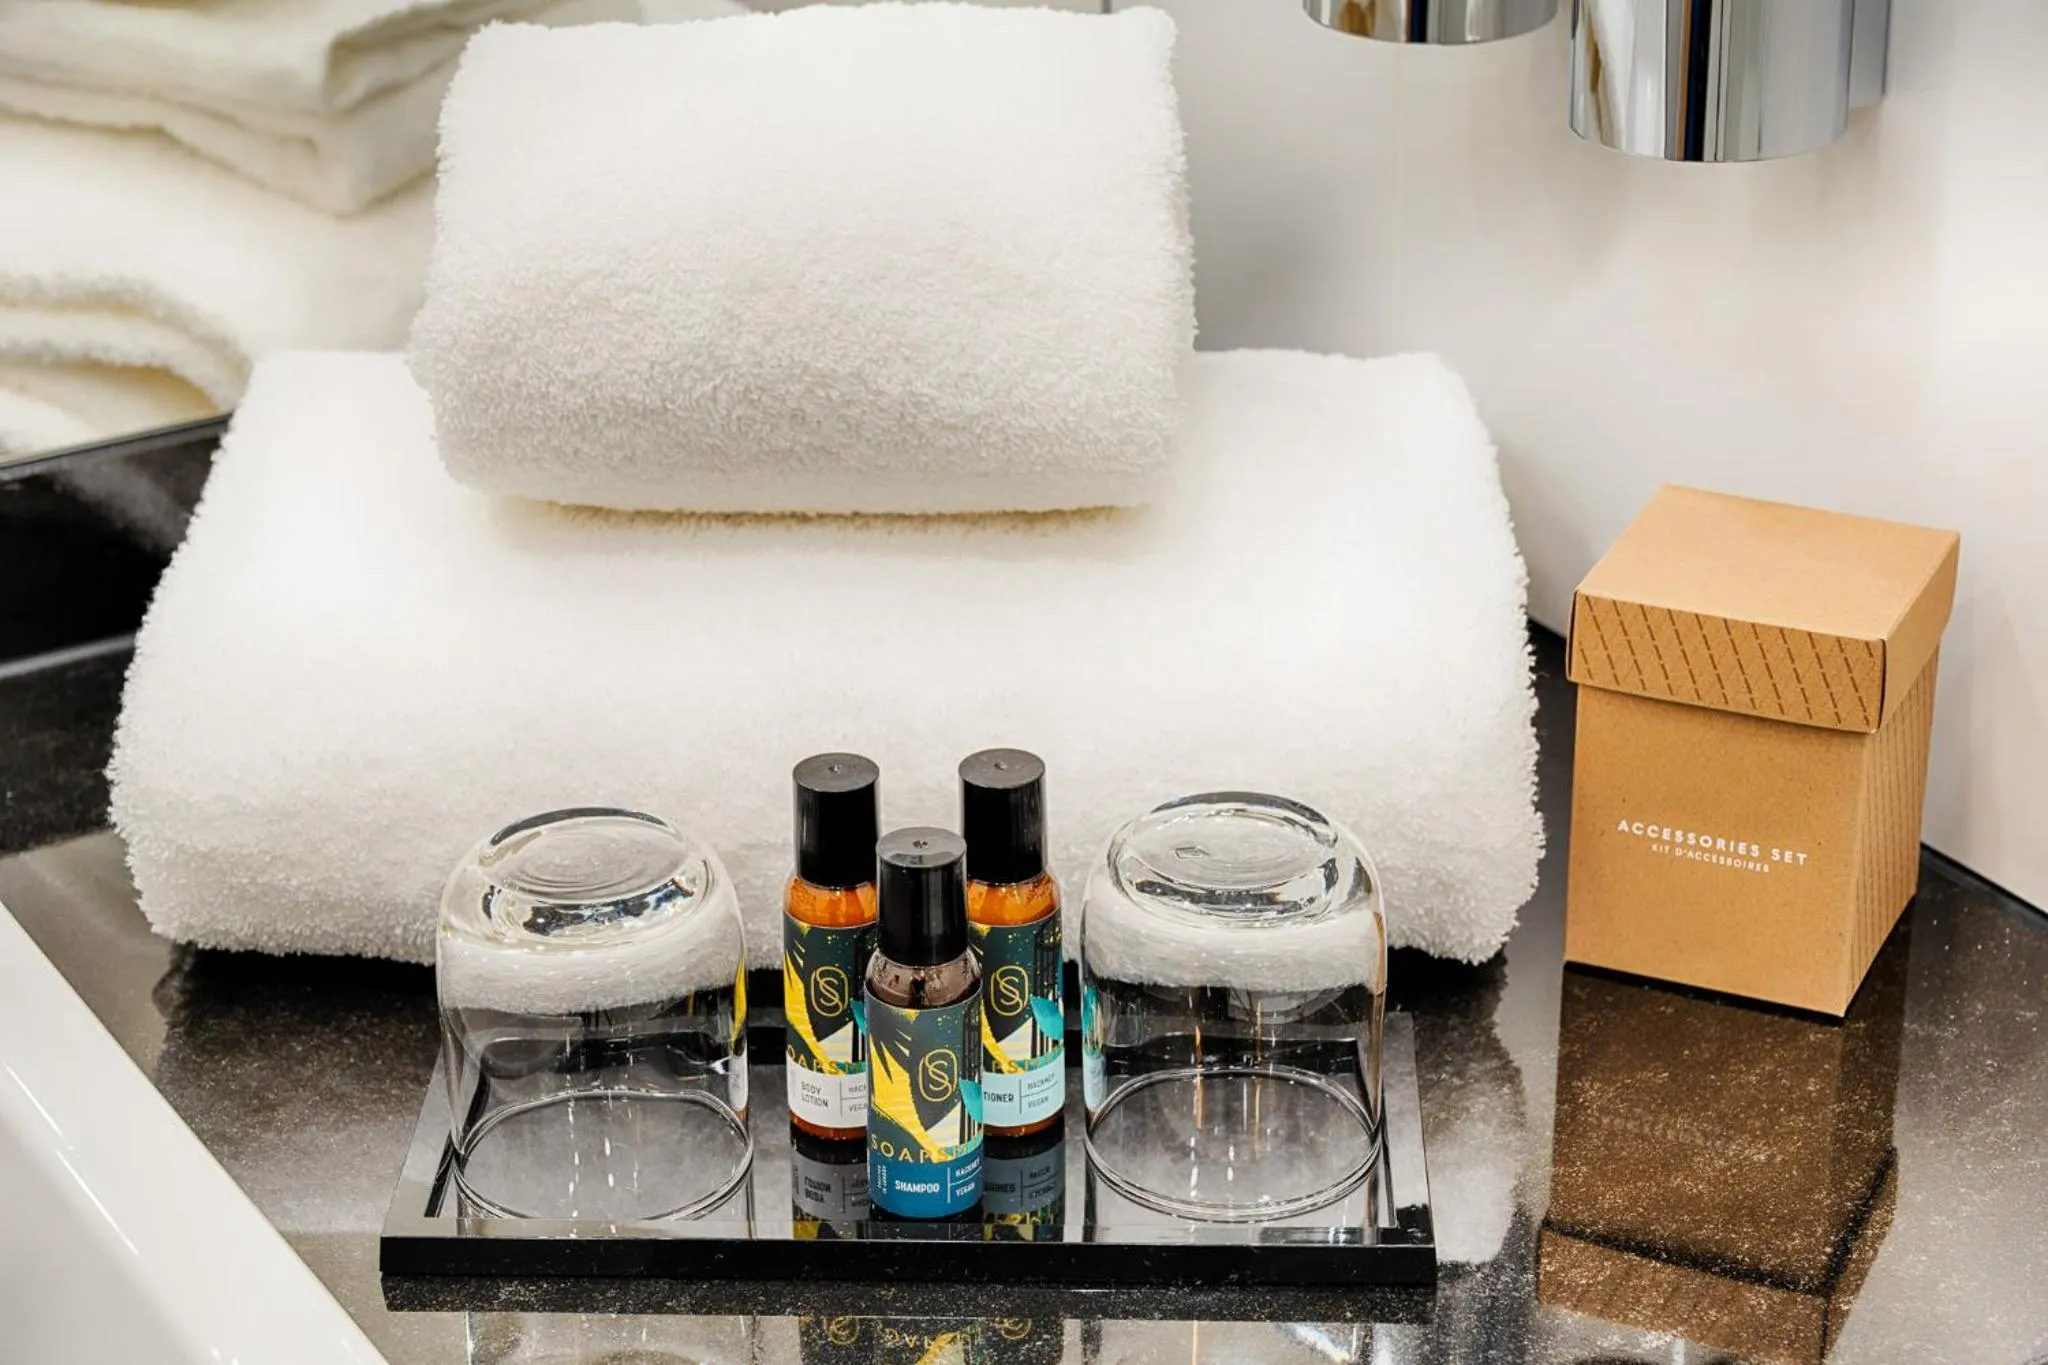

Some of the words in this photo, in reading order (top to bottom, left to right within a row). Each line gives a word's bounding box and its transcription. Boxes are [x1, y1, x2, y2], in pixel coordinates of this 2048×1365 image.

[1617, 819, 1760, 857] ACCESSORIES
[1770, 847, 1808, 866] SET
[1651, 843, 1670, 854] KIT
[1674, 847, 1770, 873] D'ACCESSOIRES
[800, 1080, 821, 1095] BODY
[801, 1093, 828, 1108] LOTION
[983, 1091, 1014, 1103] TIONER
[1027, 1094, 1049, 1108] VEGAN
[895, 1180, 940, 1194] SHAMPOO
[955, 1181, 976, 1197] VEGAN
